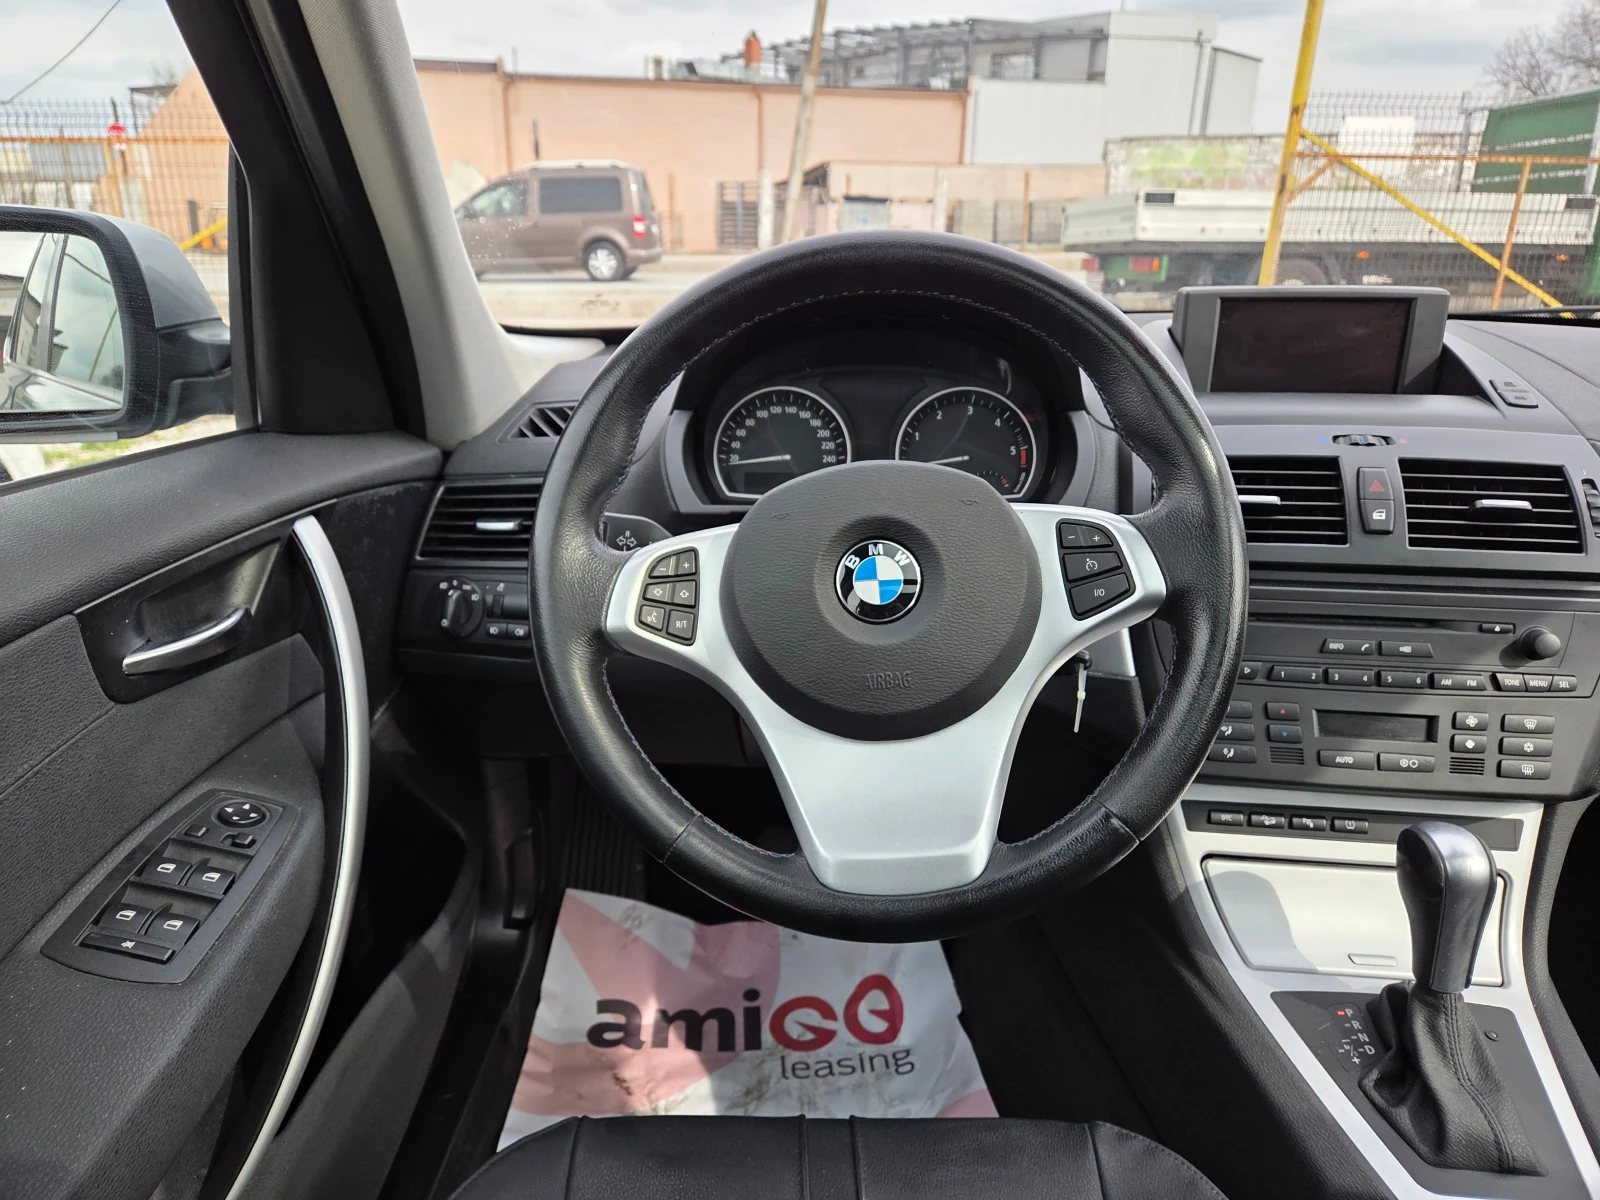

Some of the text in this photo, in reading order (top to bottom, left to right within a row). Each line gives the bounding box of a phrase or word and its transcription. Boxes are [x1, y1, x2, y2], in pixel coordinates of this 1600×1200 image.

[756, 410, 768, 418] 100
[769, 406, 782, 414] 120
[785, 406, 797, 414] 140
[967, 405, 974, 415] 3
[799, 411, 811, 419] 160
[936, 410, 942, 420] 2
[745, 418, 755, 426] 80
[809, 418, 822, 427] 180
[994, 418, 1001, 427] 4
[736, 428, 746, 437] 60
[817, 429, 830, 438] 200
[914, 432, 919, 441] 1
[730, 441, 741, 450] 40
[821, 441, 835, 450] 220
[1010, 446, 1016, 456] 5
[729, 454, 739, 462] 20
[822, 455, 836, 463] 240
[845, 543, 910, 570] BMW
[675, 620, 687, 628] R/T
[1328, 642, 1344, 650] INFO
[865, 671, 912, 689] AIRBAG
[1416, 677, 1421, 685] 6
[1503, 678, 1520, 687] TONE
[1529, 680, 1548, 688] MENU
[1335, 756, 1354, 764] AUTO
[1345, 1008, 1353, 1017] P
[1351, 1020, 1362, 1030] R
[1357, 1032, 1370, 1042] N
[1364, 1045, 1375, 1055] D
[780, 1048, 915, 1080] leasing
